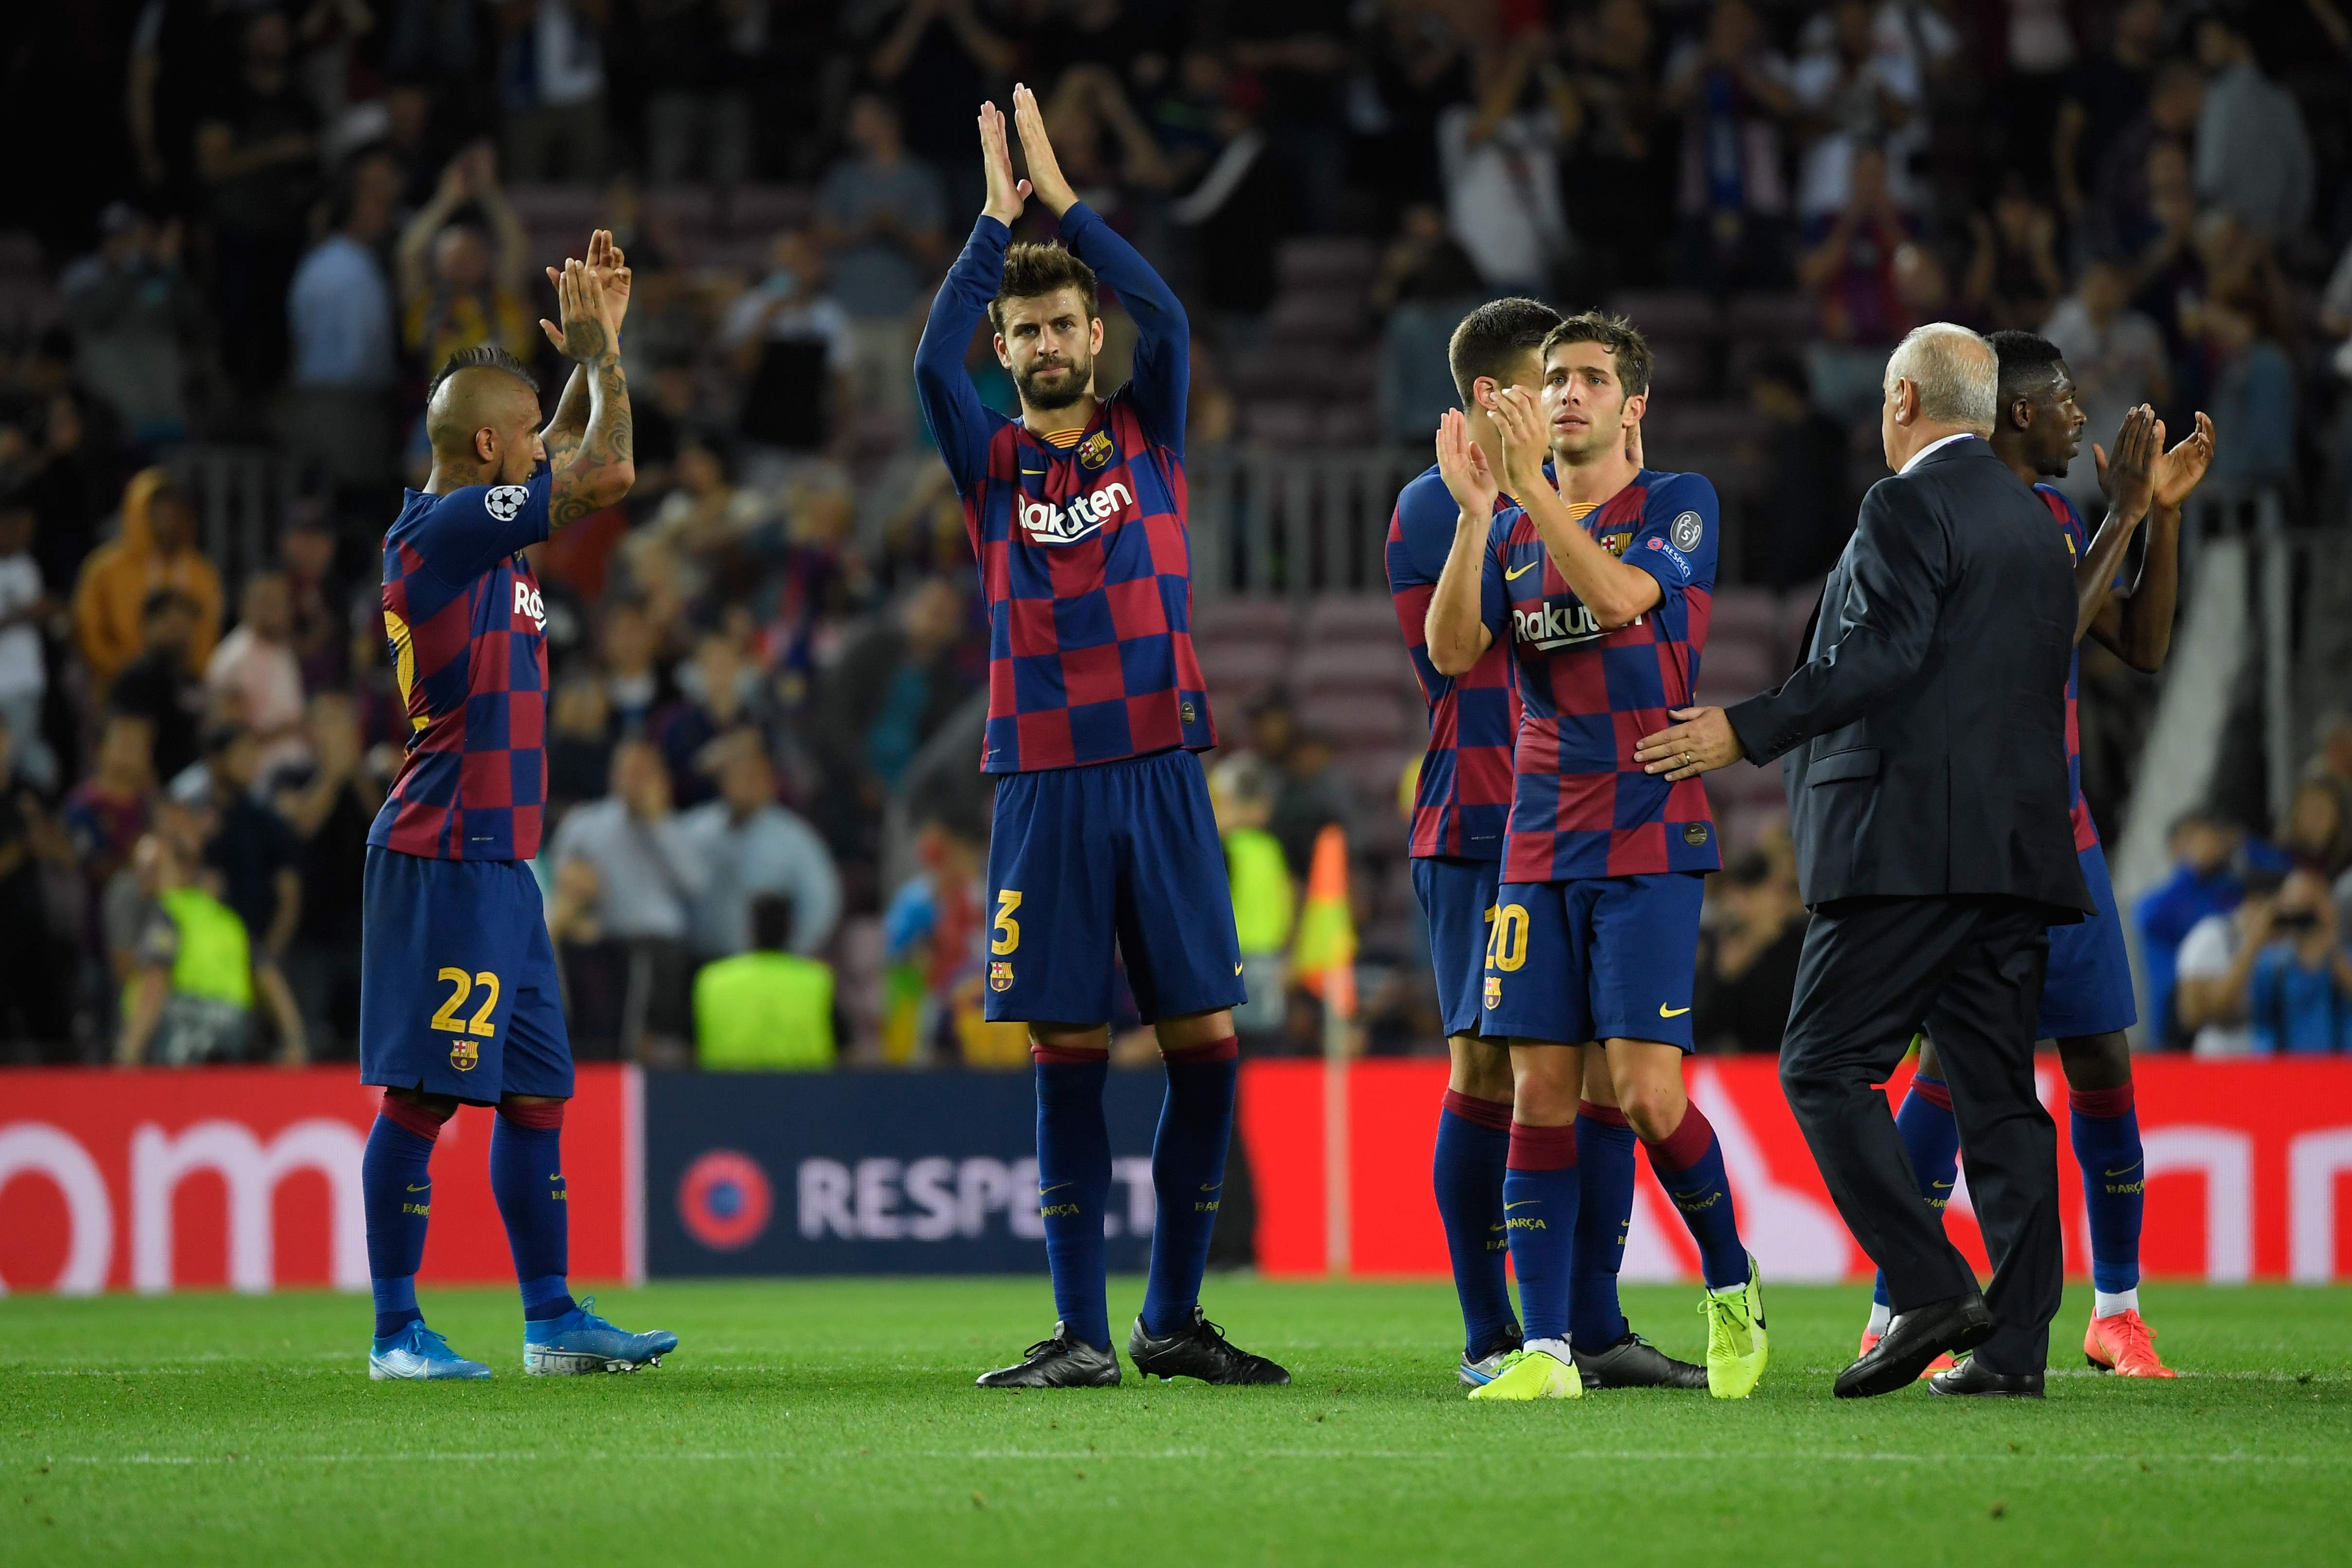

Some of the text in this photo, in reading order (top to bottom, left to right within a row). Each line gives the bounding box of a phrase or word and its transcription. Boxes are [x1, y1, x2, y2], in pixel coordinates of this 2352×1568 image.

[1019, 482, 1133, 537] Rakuten
[1681, 530, 1691, 541] 5
[1662, 544, 1691, 578] RESPECT
[1512, 601, 1643, 643] Rakut
[991, 889, 1022, 956] 3
[431, 967, 500, 1037] 22
[403, 1203, 430, 1218] BARÇ
[798, 1157, 1155, 1241] RESPET
[1507, 1218, 1546, 1230] BARÇA
